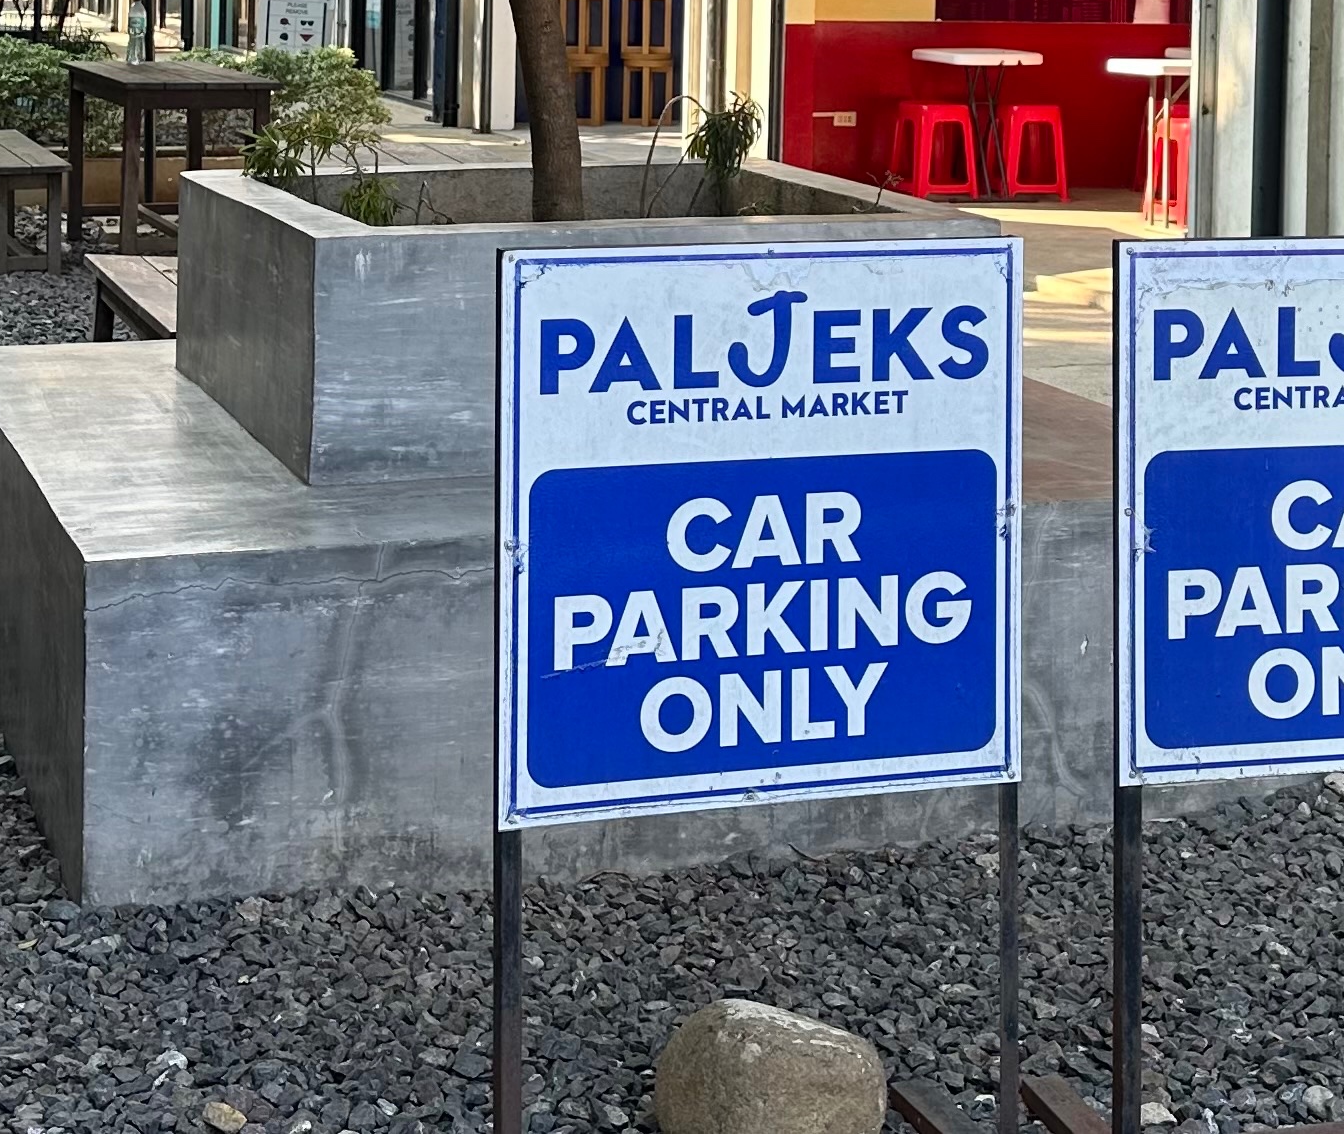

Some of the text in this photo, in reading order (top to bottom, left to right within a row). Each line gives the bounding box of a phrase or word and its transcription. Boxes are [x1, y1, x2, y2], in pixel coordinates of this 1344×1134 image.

[539, 291, 989, 395] PALJEKS
[627, 390, 909, 425] CENTRAL MARKET
[666, 491, 862, 573] CAR
[553, 570, 973, 671] PARKING
[639, 662, 889, 753] ONLY
